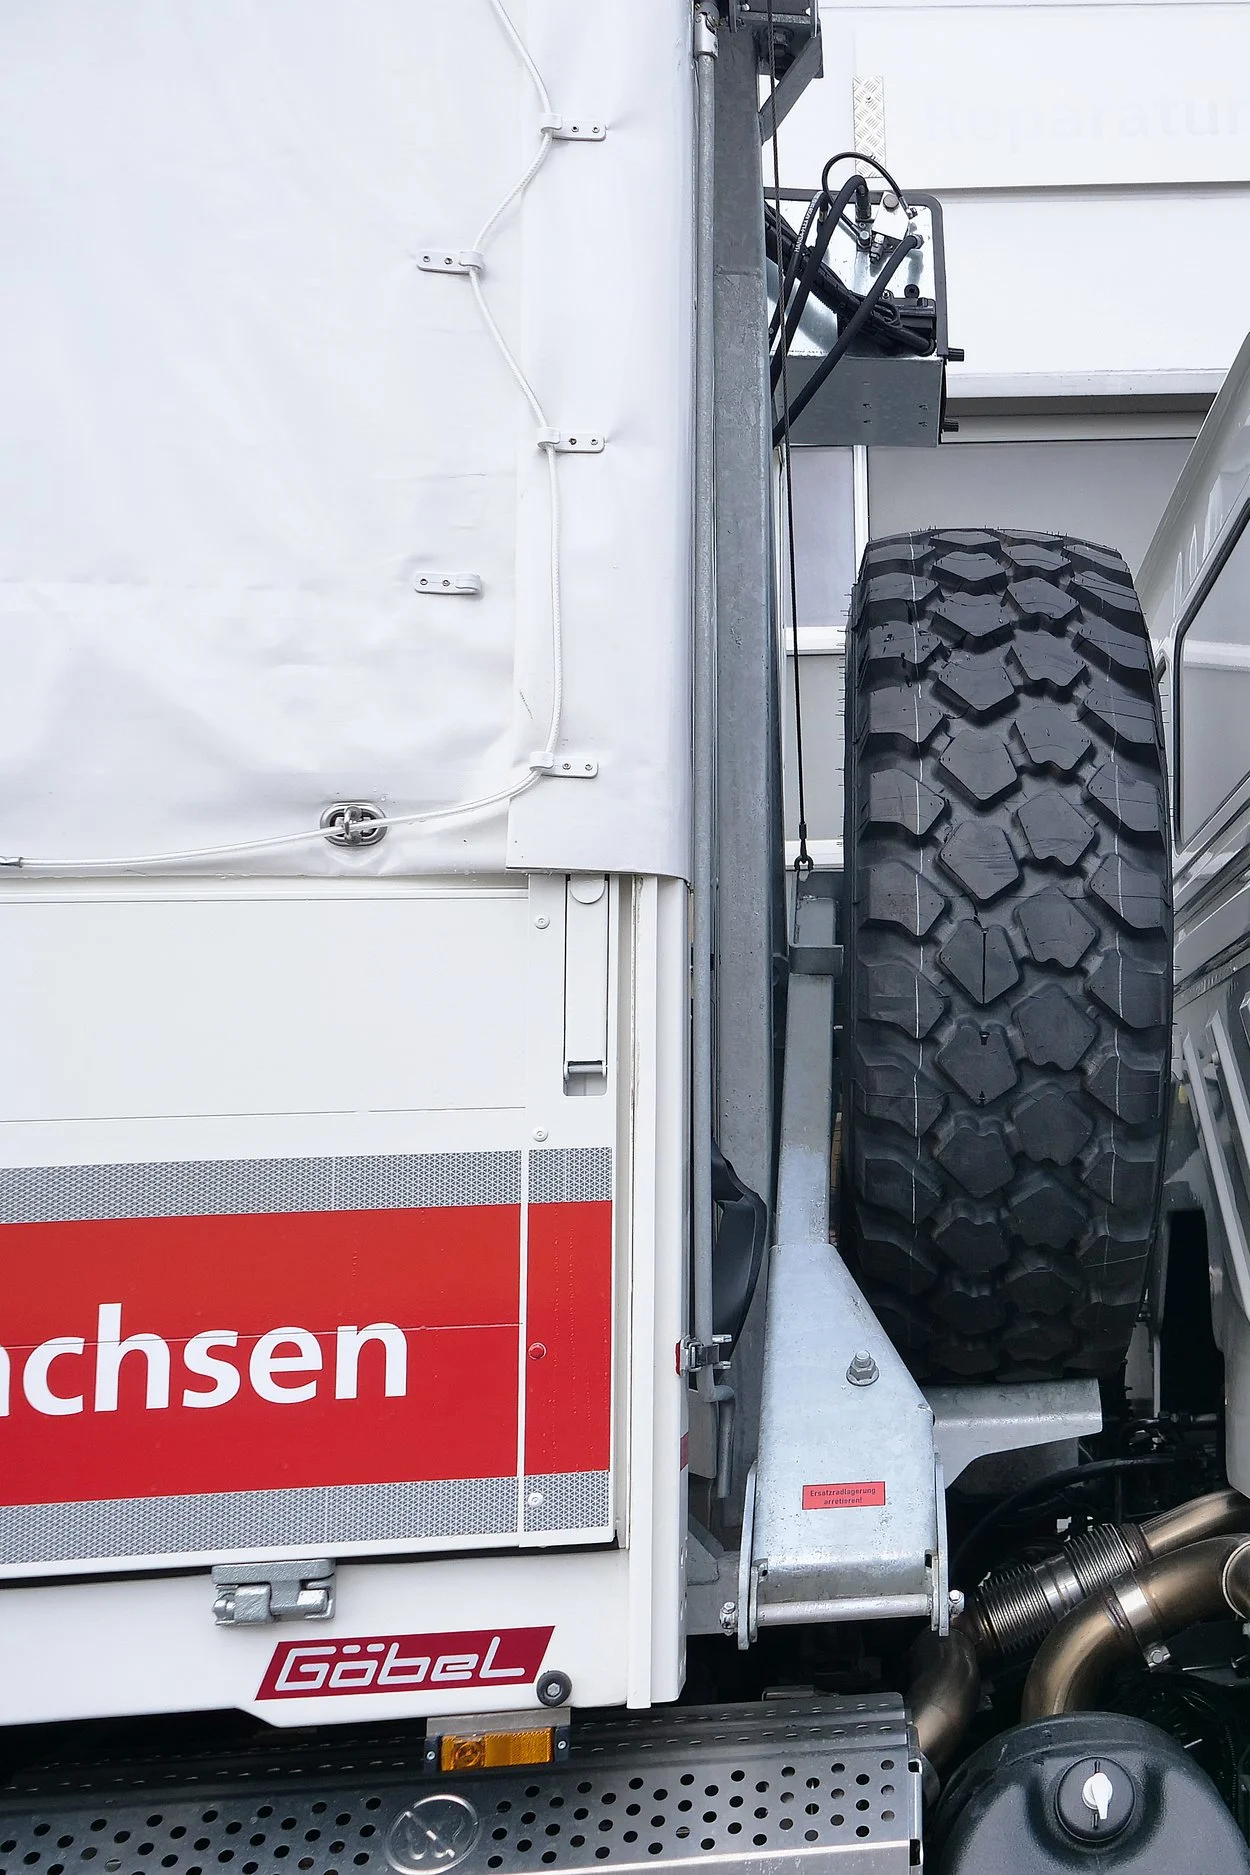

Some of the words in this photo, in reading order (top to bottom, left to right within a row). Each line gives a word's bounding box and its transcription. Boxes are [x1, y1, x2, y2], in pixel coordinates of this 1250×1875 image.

[0, 1302, 408, 1417] chsen
[810, 1488, 876, 1497] Ersatzradlagerung
[823, 1497, 863, 1505] arretieren!
